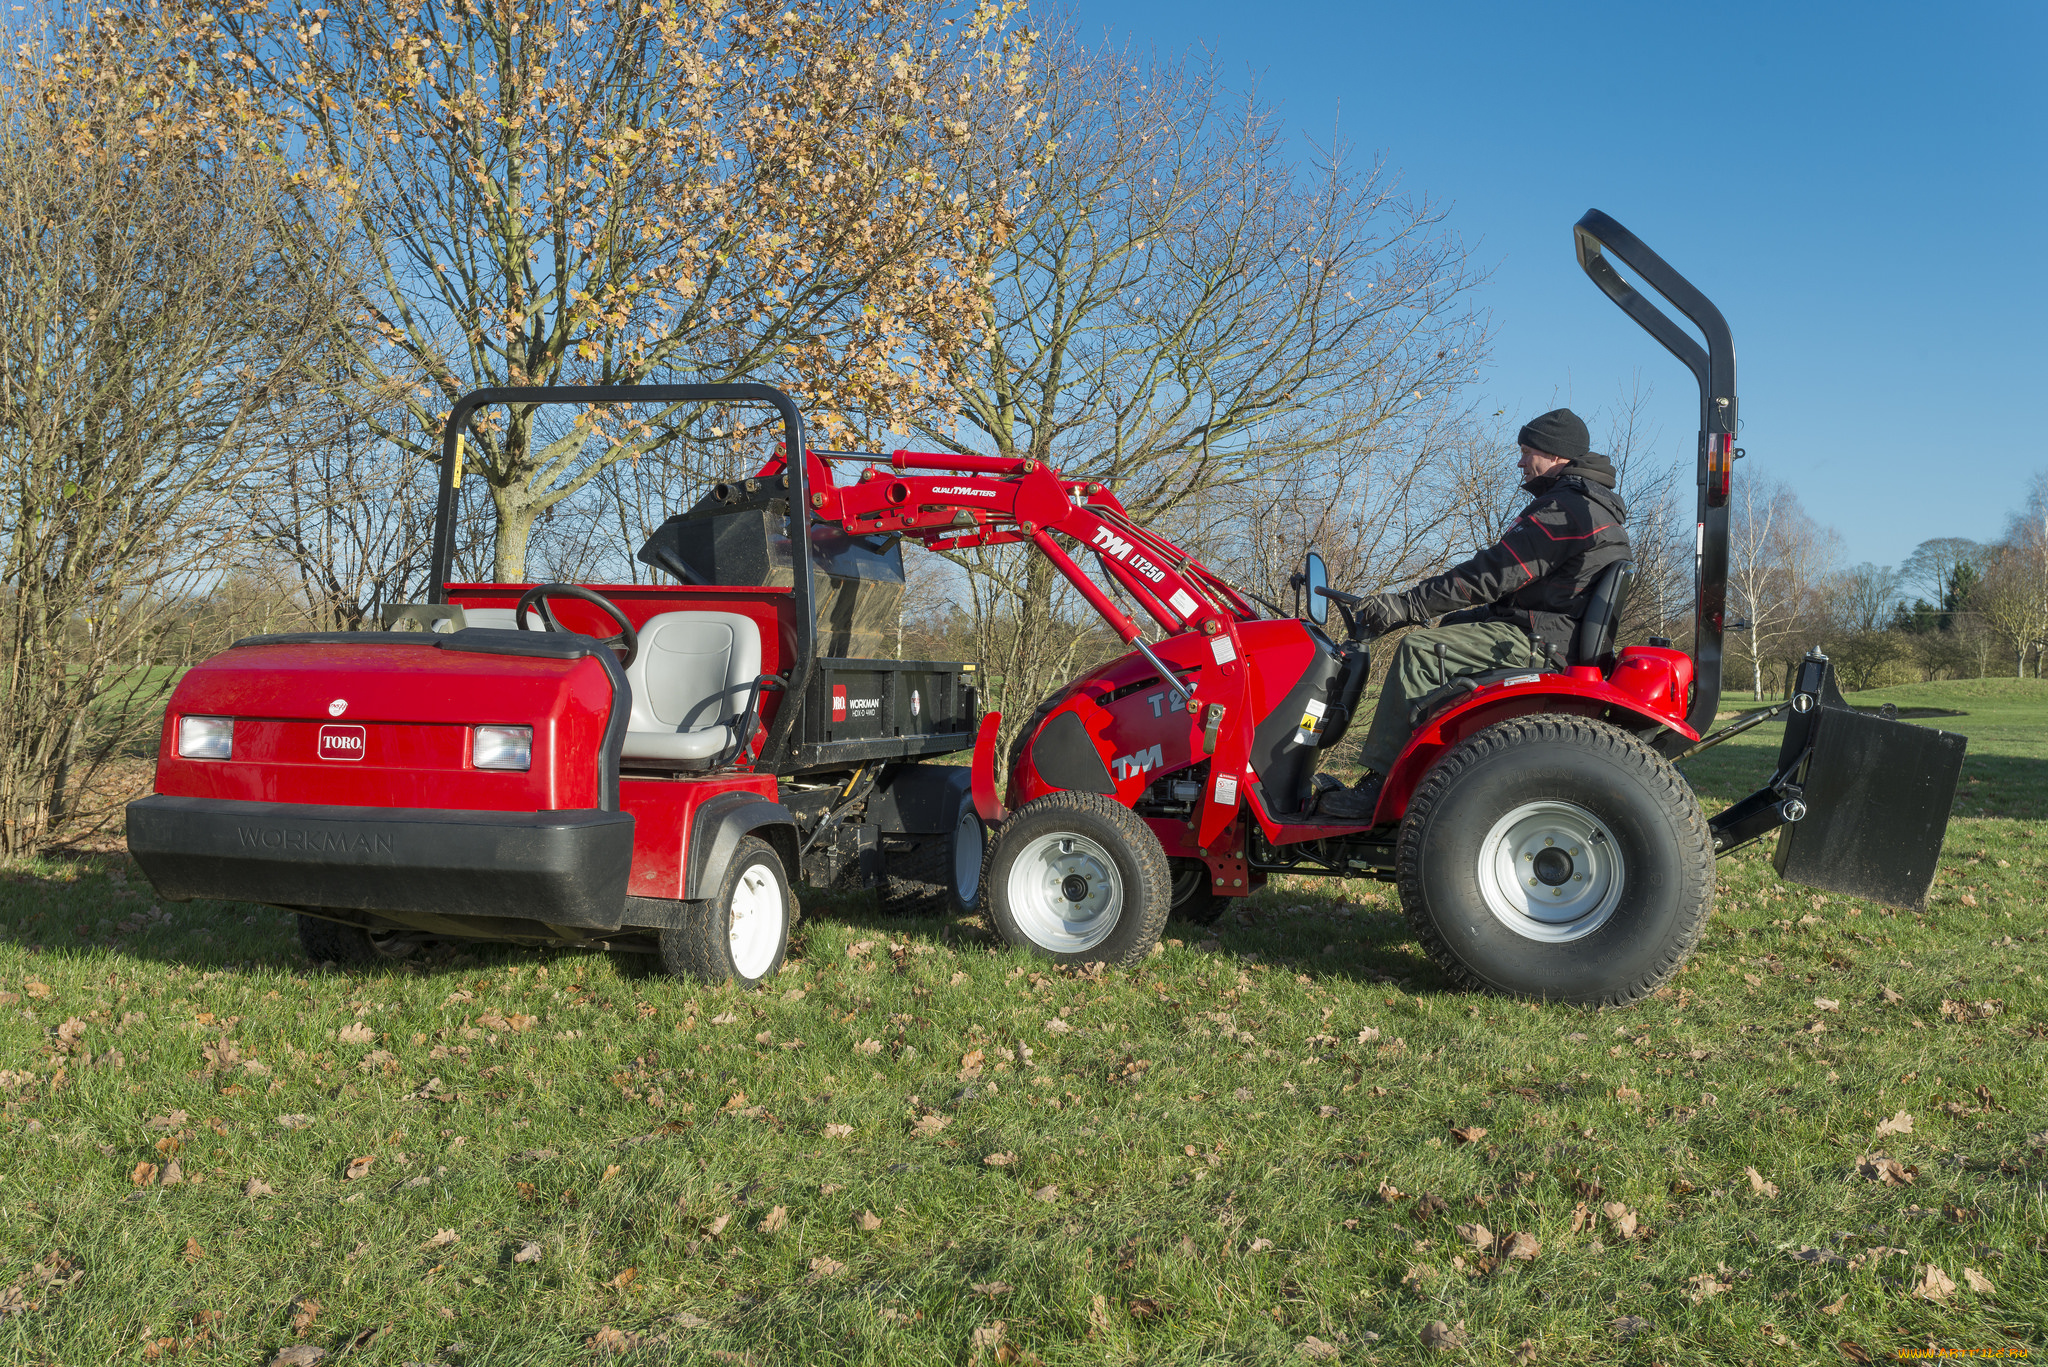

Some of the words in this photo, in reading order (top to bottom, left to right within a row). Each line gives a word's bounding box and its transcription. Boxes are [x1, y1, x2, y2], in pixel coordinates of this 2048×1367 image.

[931, 486, 997, 497] QUALITYMATTERS
[1091, 525, 1134, 561] TYM
[1128, 553, 1167, 584] LT250
[849, 699, 880, 709] WORKMAN
[1147, 691, 1165, 719] T
[323, 735, 362, 749] TORO
[1111, 743, 1164, 782] TYM
[237, 826, 394, 854] WORKMAN
